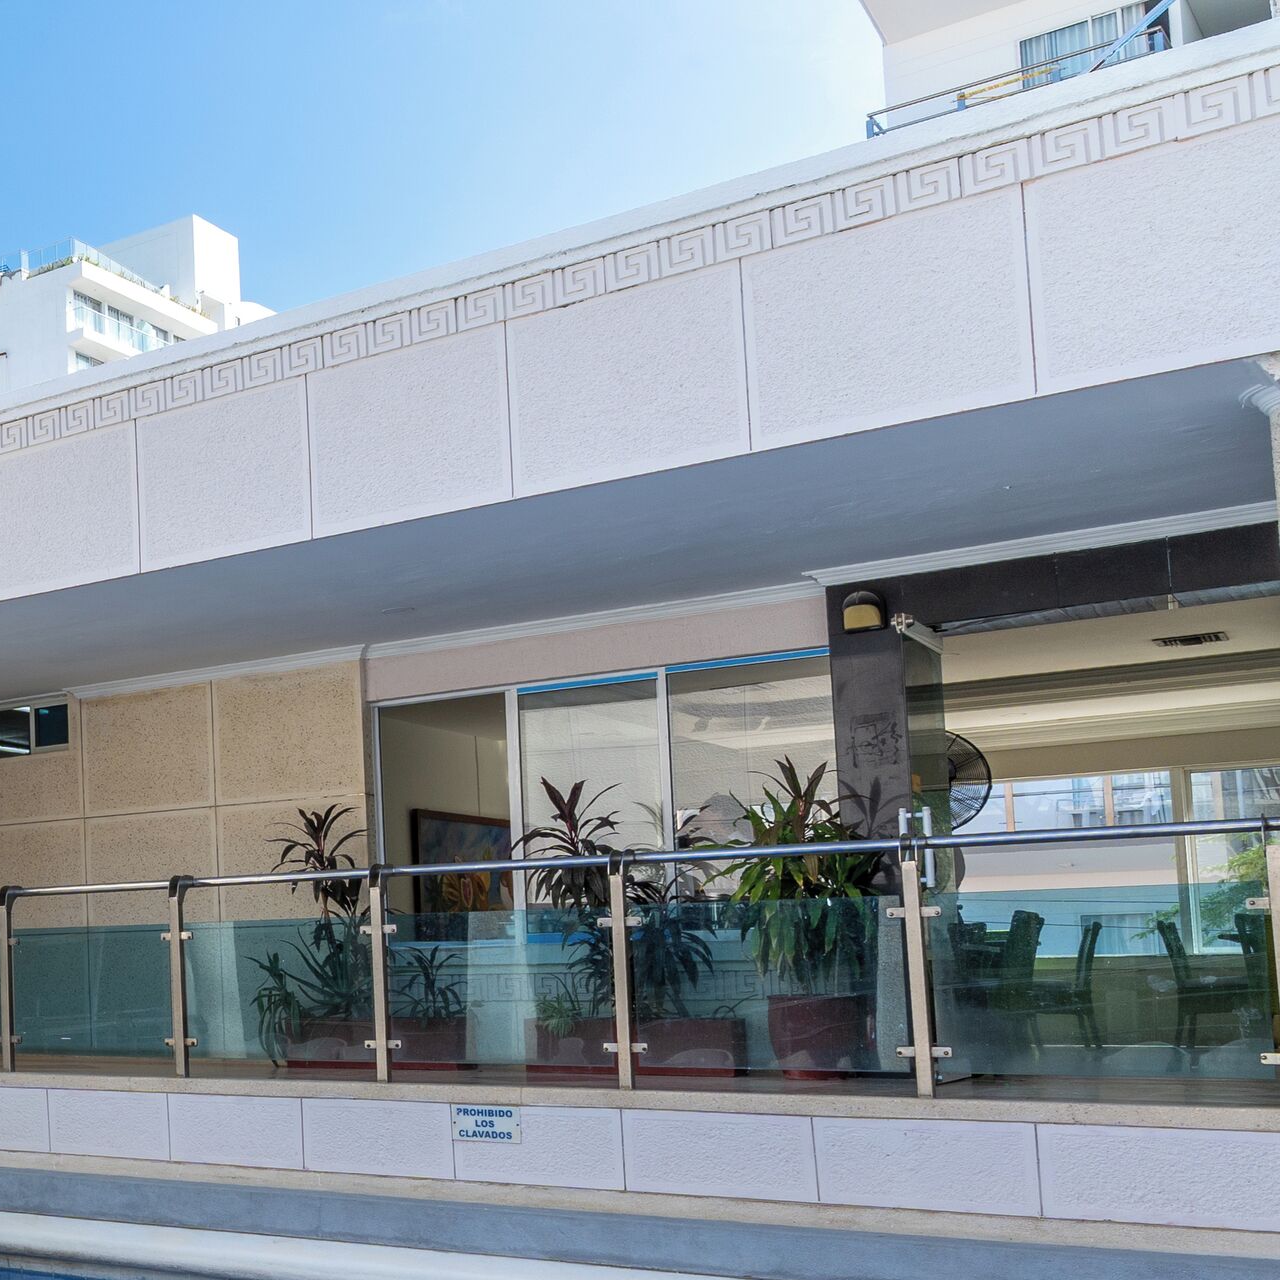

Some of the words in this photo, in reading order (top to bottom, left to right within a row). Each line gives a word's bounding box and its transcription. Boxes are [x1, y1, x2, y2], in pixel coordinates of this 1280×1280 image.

[456, 1108, 513, 1118] PROHIBIDO
[475, 1119, 495, 1128] LOS
[458, 1129, 513, 1140] CLAVADOS
